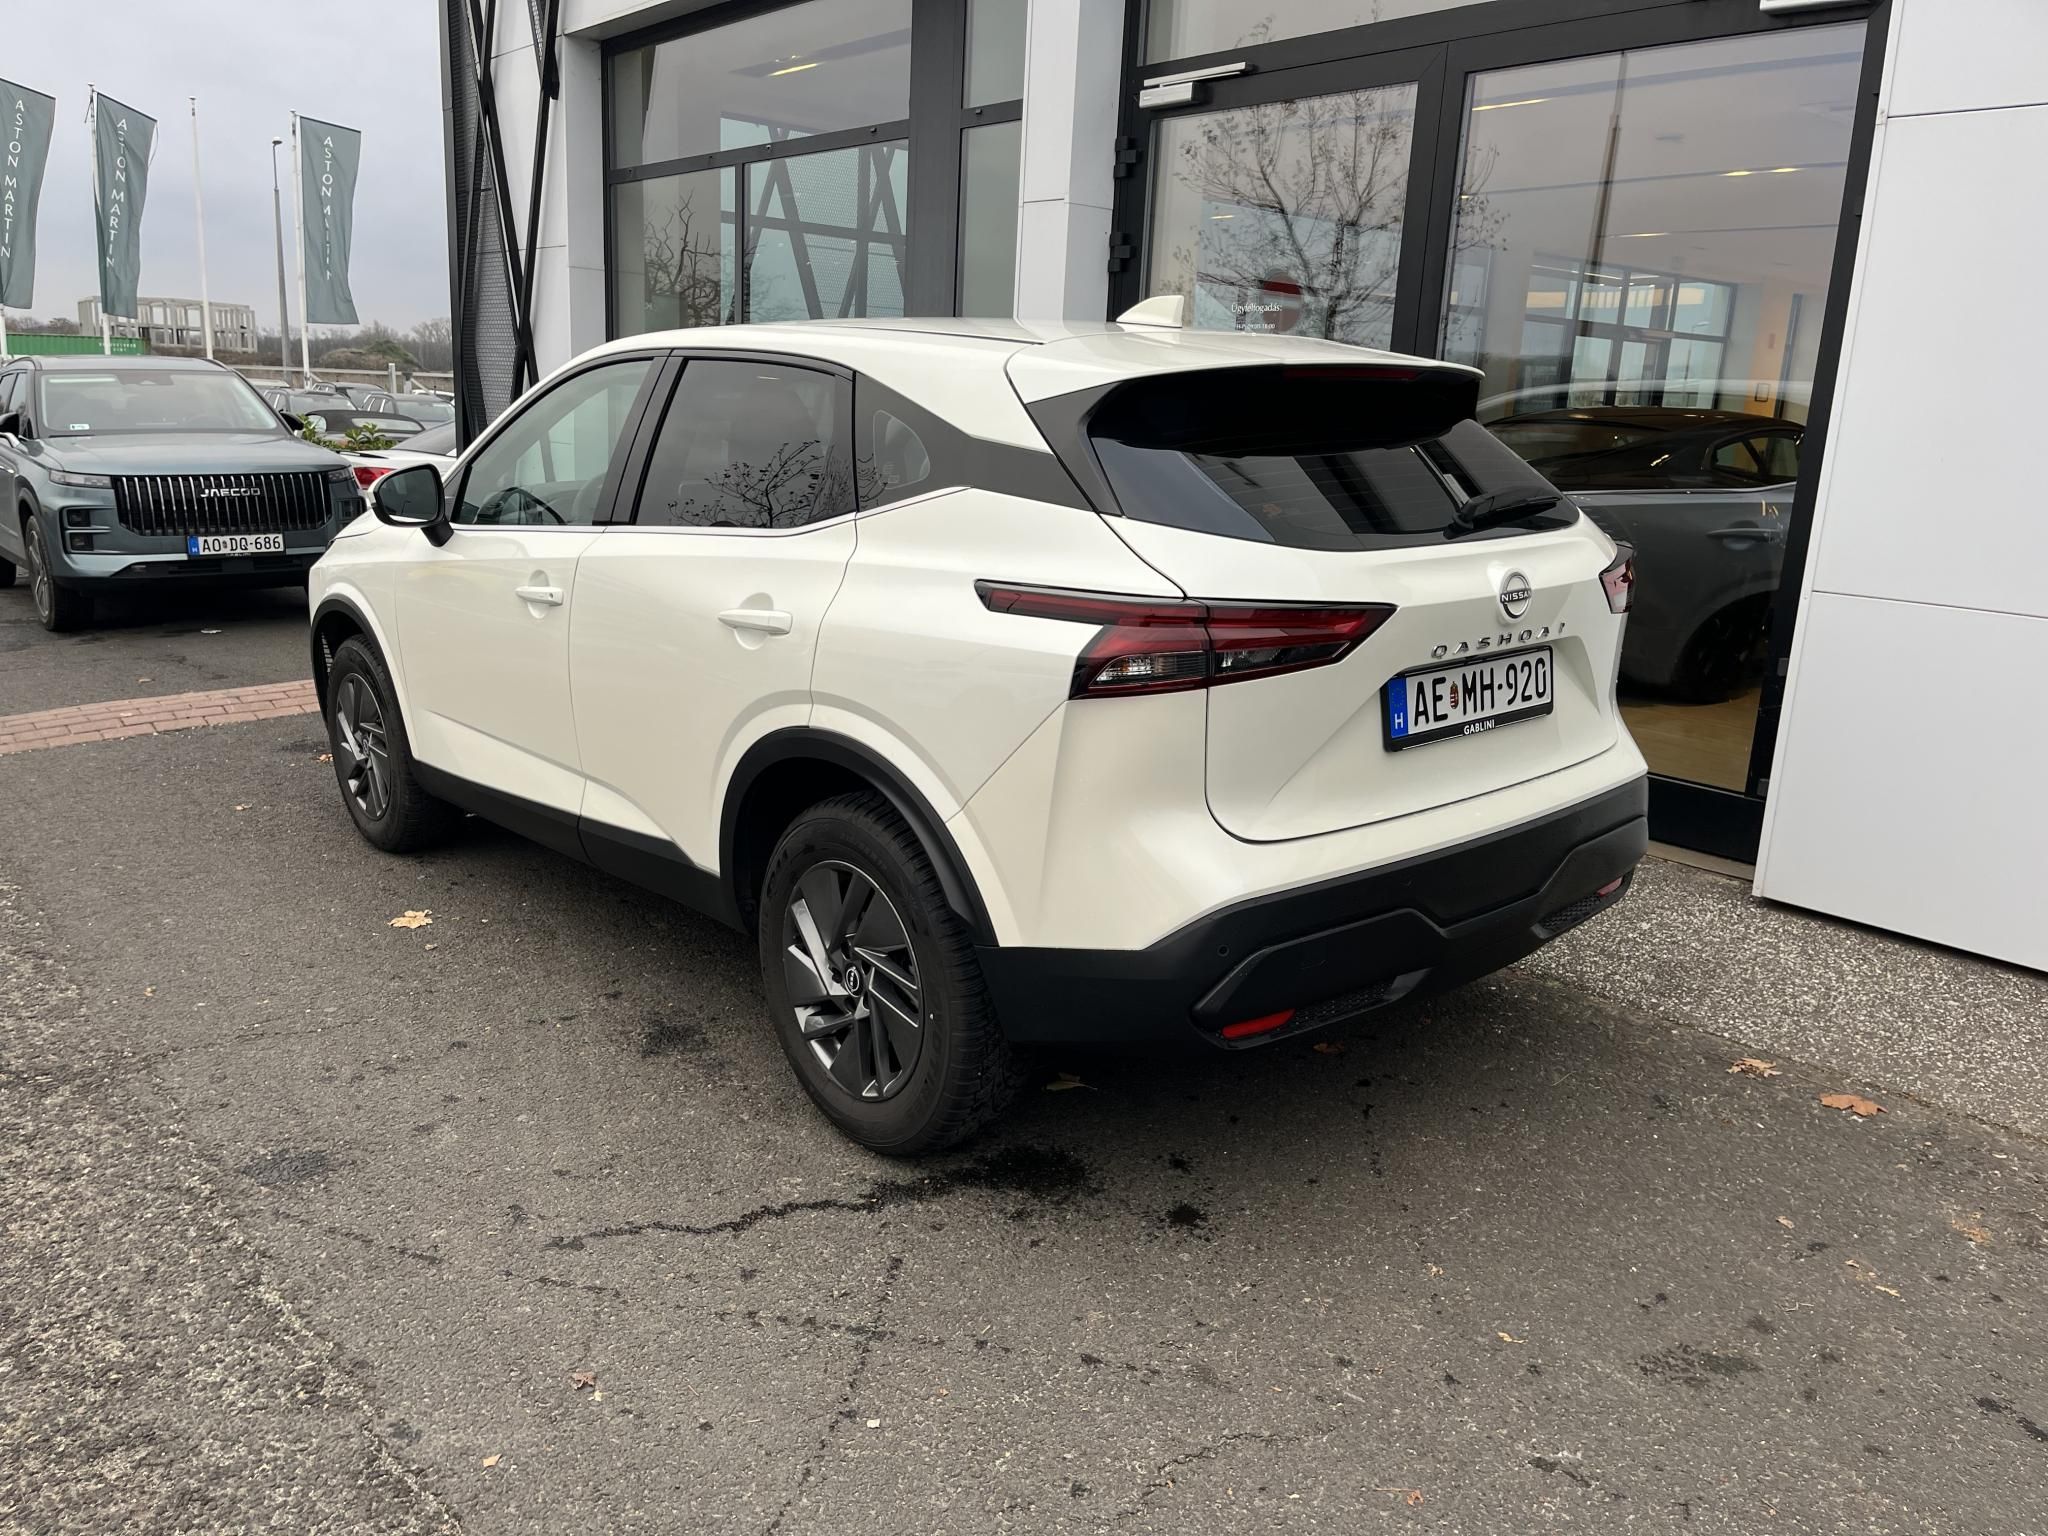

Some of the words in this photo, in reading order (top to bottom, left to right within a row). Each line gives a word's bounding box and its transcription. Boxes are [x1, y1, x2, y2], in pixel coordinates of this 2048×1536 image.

[8, 99, 25, 168] ASTON
[321, 135, 334, 198] ASTON
[0, 174, 17, 258] MARTIN
[105, 188, 125, 268] MARTIN
[200, 487, 261, 498] JAECOO
[229, 535, 281, 552] DQ-686
[1394, 712, 1404, 730] H
[1463, 719, 1496, 736] GABLINI
